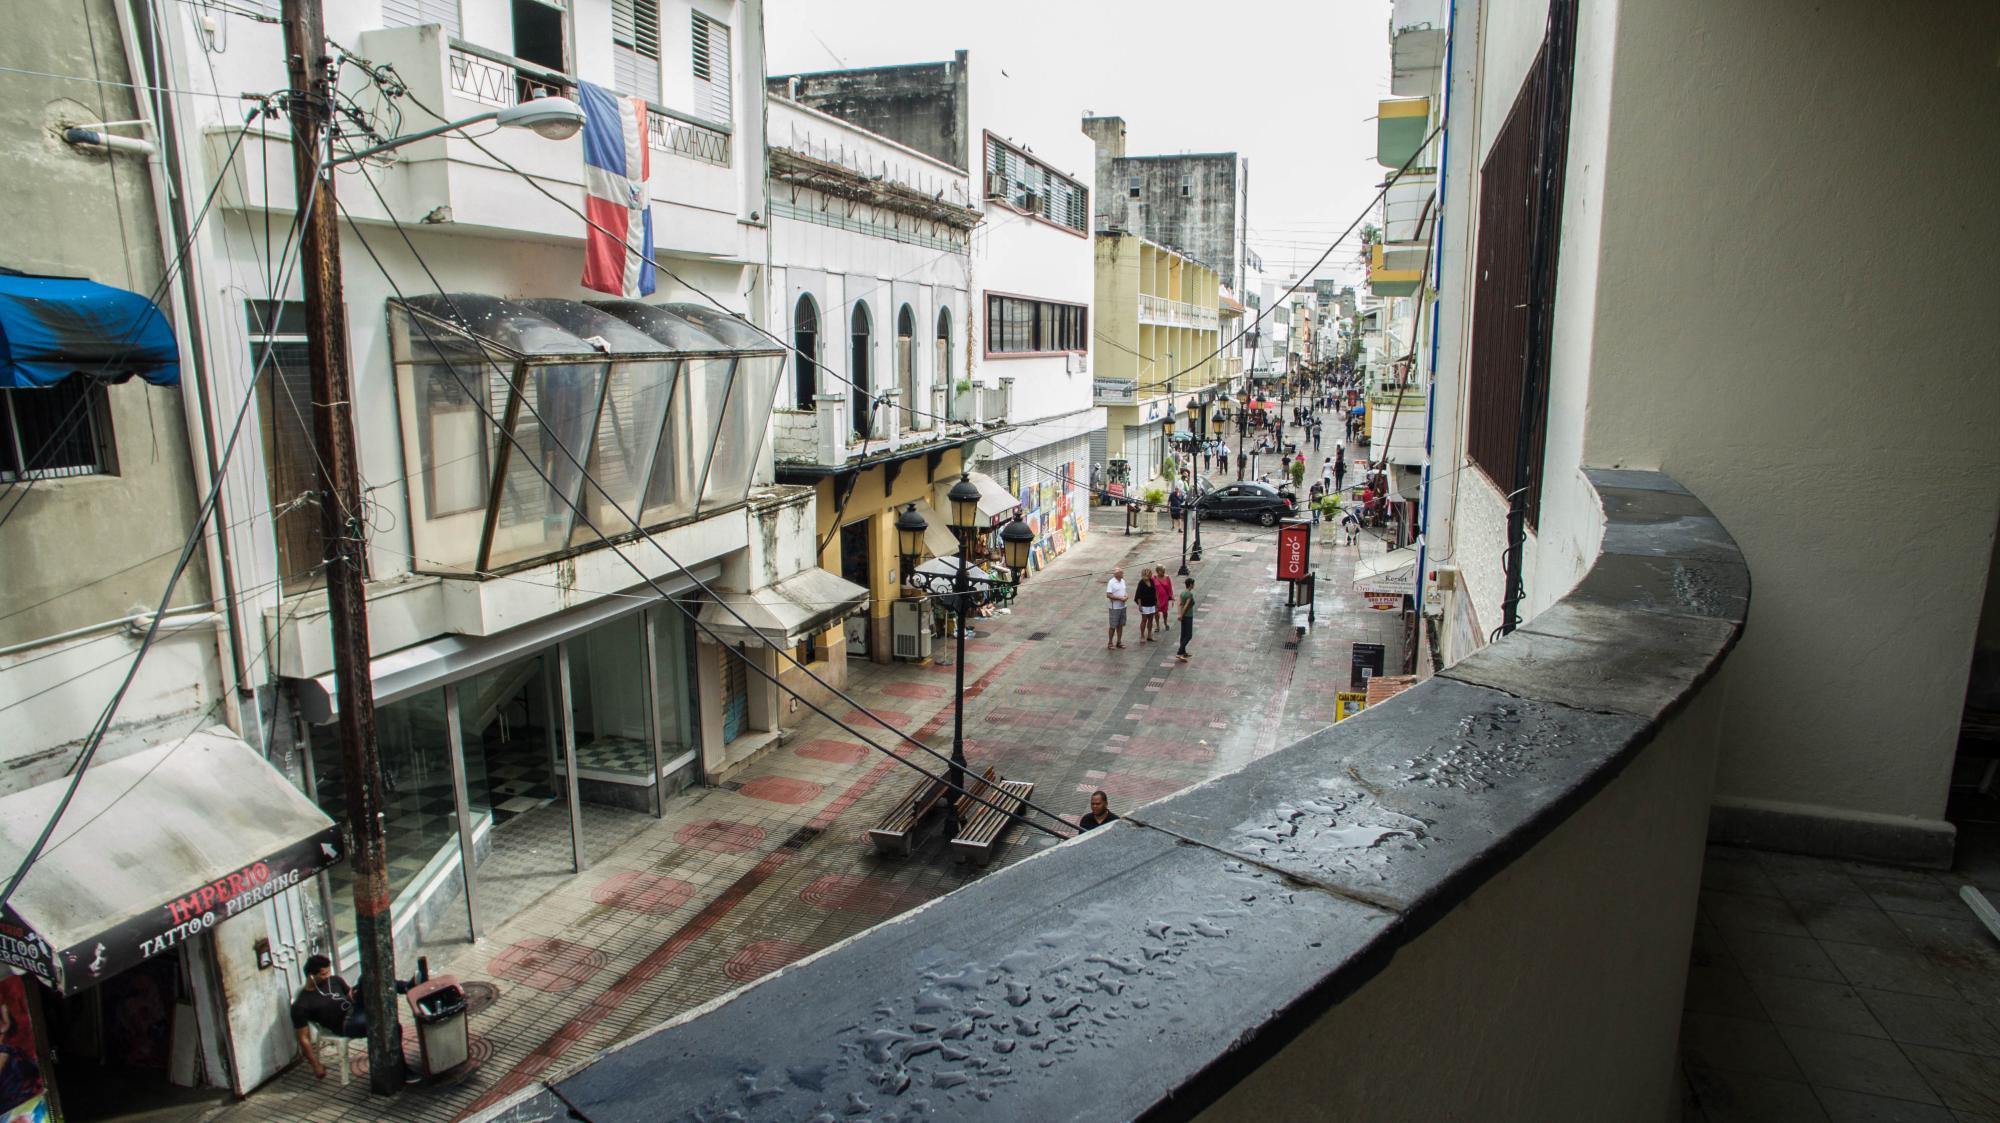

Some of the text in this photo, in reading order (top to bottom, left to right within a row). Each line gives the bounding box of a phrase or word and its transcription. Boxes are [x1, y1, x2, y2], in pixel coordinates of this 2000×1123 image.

[1287, 538, 1300, 573] Claro
[139, 868, 299, 958] TATTOO PIERCING
[167, 862, 270, 925] IMPERIO
